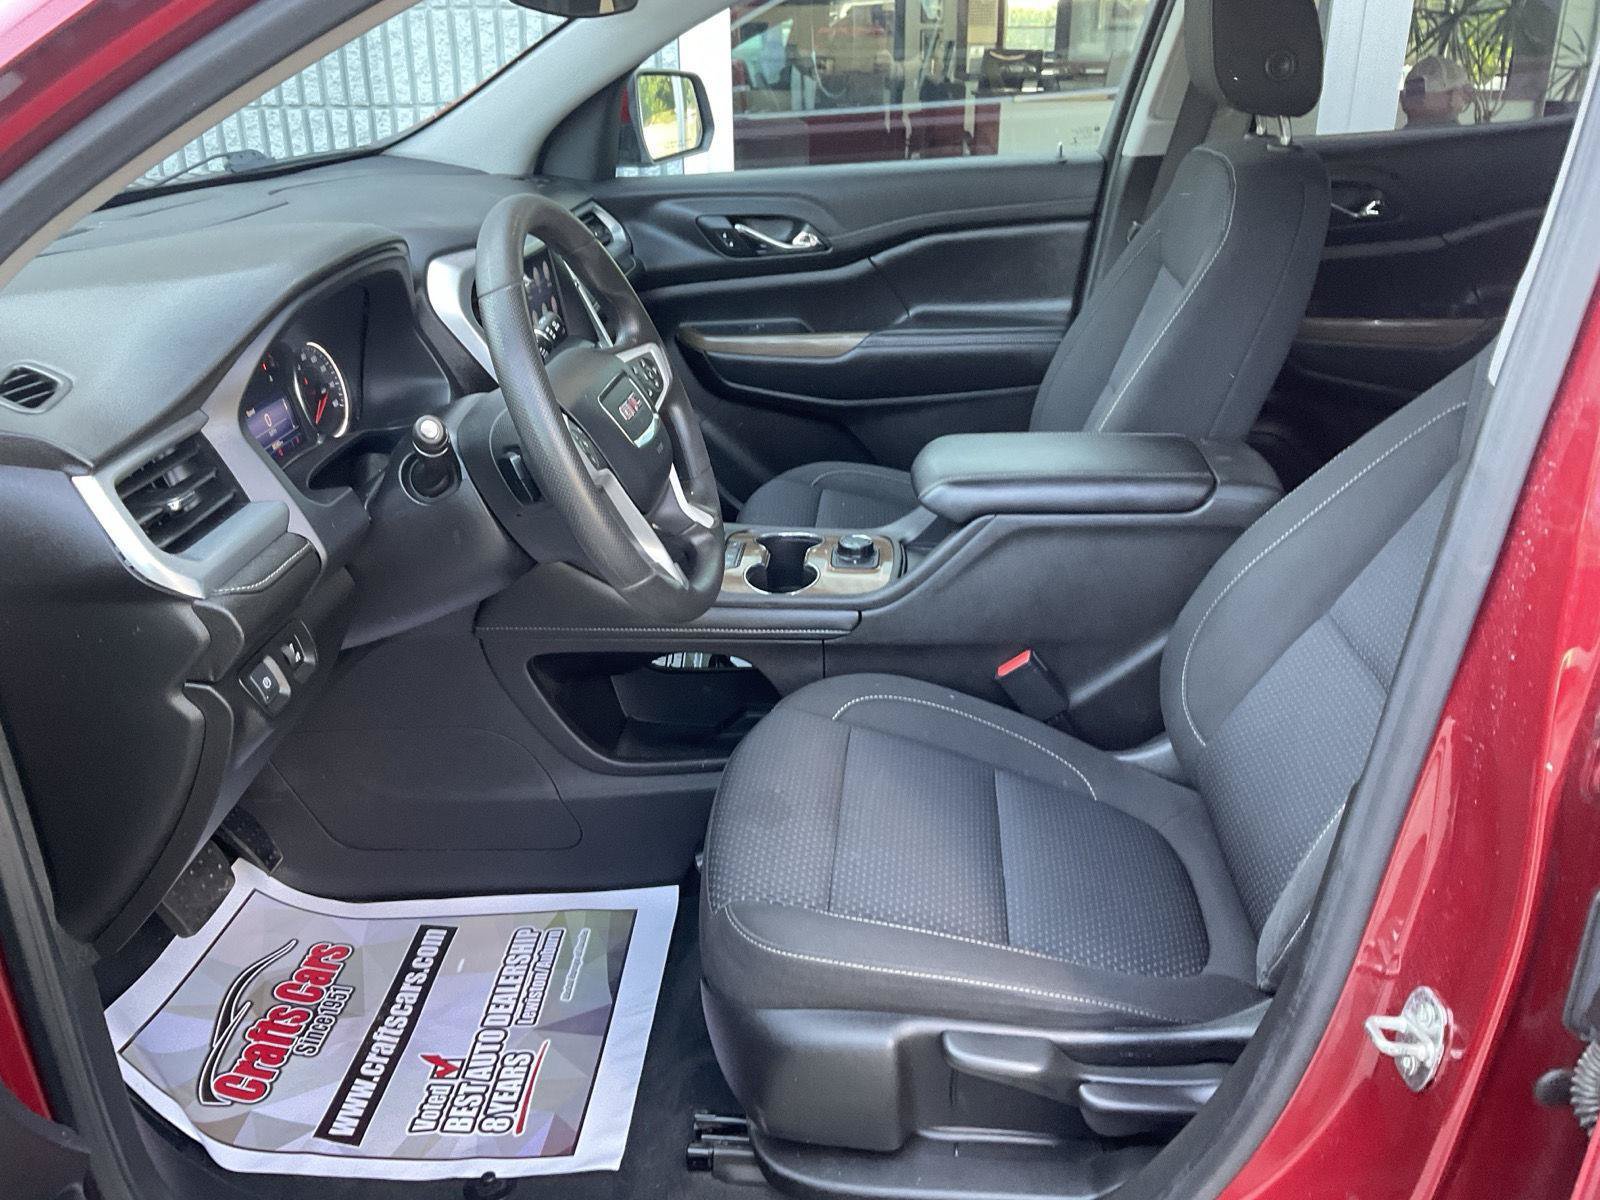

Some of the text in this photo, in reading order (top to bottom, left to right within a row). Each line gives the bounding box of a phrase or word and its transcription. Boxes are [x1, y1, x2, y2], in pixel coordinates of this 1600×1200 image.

[212, 941, 353, 1104] Crafts Cars
[296, 985, 355, 1056] Since 1951
[328, 928, 448, 1136] www.craftscars.com
[442, 927, 541, 1133] BEST AUTO DEALERSHIP
[411, 1082, 452, 1133] Voted
[488, 1053, 533, 1115] YEARS
